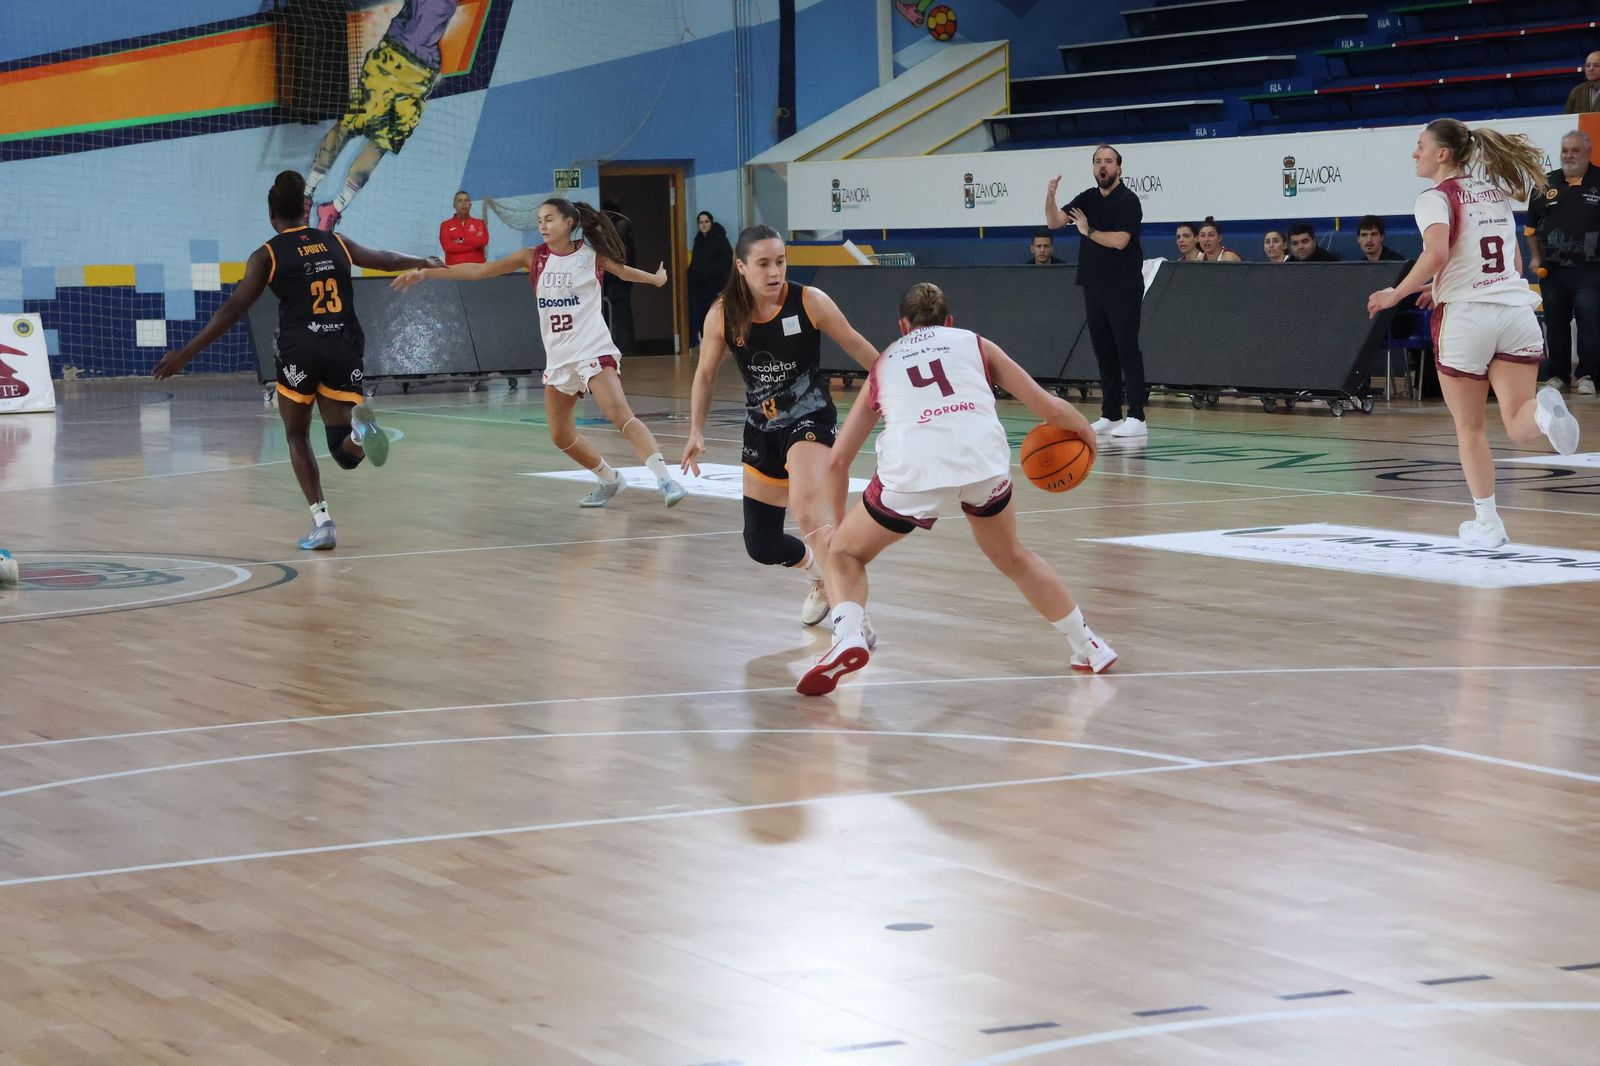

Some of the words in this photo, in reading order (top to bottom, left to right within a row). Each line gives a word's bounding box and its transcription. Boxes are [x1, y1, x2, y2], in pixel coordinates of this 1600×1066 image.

[1125, 175, 1163, 192] ZAMORA
[1298, 166, 1342, 184] ZAMORA
[841, 187, 871, 202] ZAMORA
[975, 182, 1008, 198] ZAMORA
[1479, 235, 1505, 273] 9
[310, 278, 342, 314] 23
[539, 295, 580, 308] Bosonit
[550, 314, 573, 332] 22
[747, 361, 797, 373] recoletas
[760, 371, 786, 383] salud
[906, 358, 955, 397] 4
[0, 384, 21, 398] TE
[1321, 537, 1600, 569] MOLENDU
